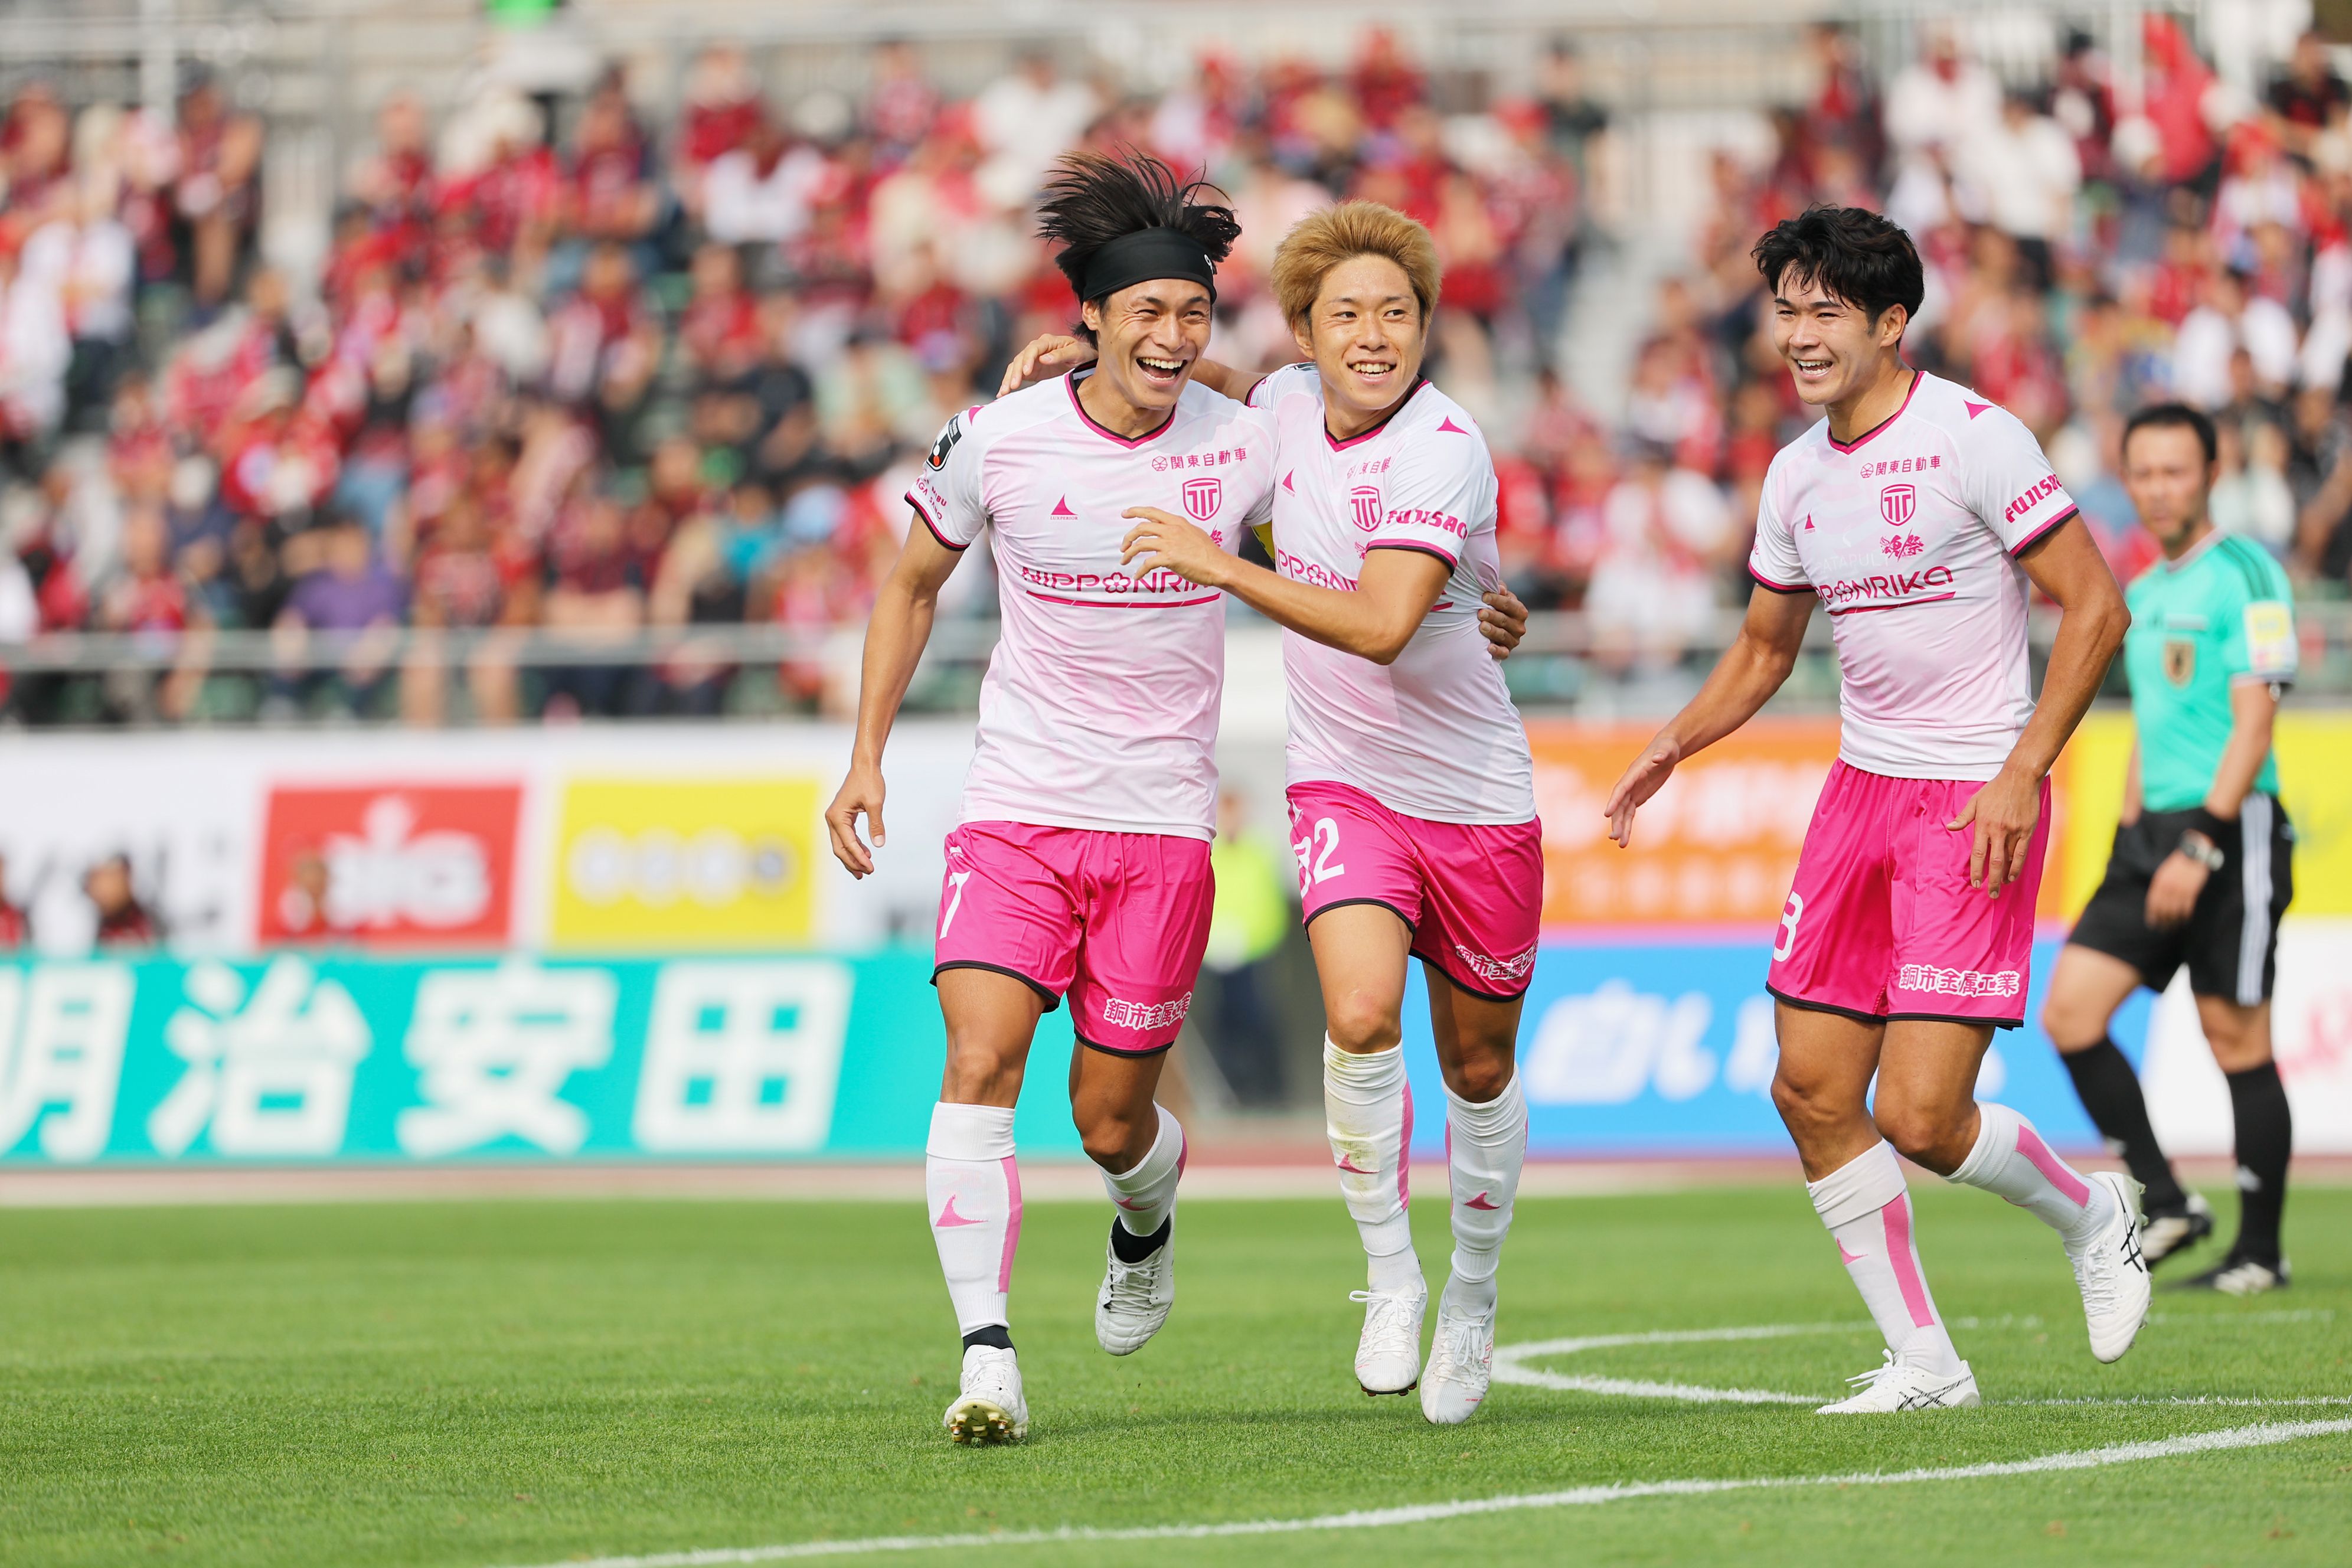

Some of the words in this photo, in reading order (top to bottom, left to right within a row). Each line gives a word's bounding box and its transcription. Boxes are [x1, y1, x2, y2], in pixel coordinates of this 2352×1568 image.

[1171, 447, 1247, 469] 関東自動車
[1876, 455, 1941, 476] 関東自動車
[1022, 567, 1208, 594] NIPPONRI
[1293, 817, 1345, 899] 32
[939, 871, 971, 940] 7
[1899, 963, 2020, 998] 銅市金属工業
[0, 950, 856, 1164] 明治安田
